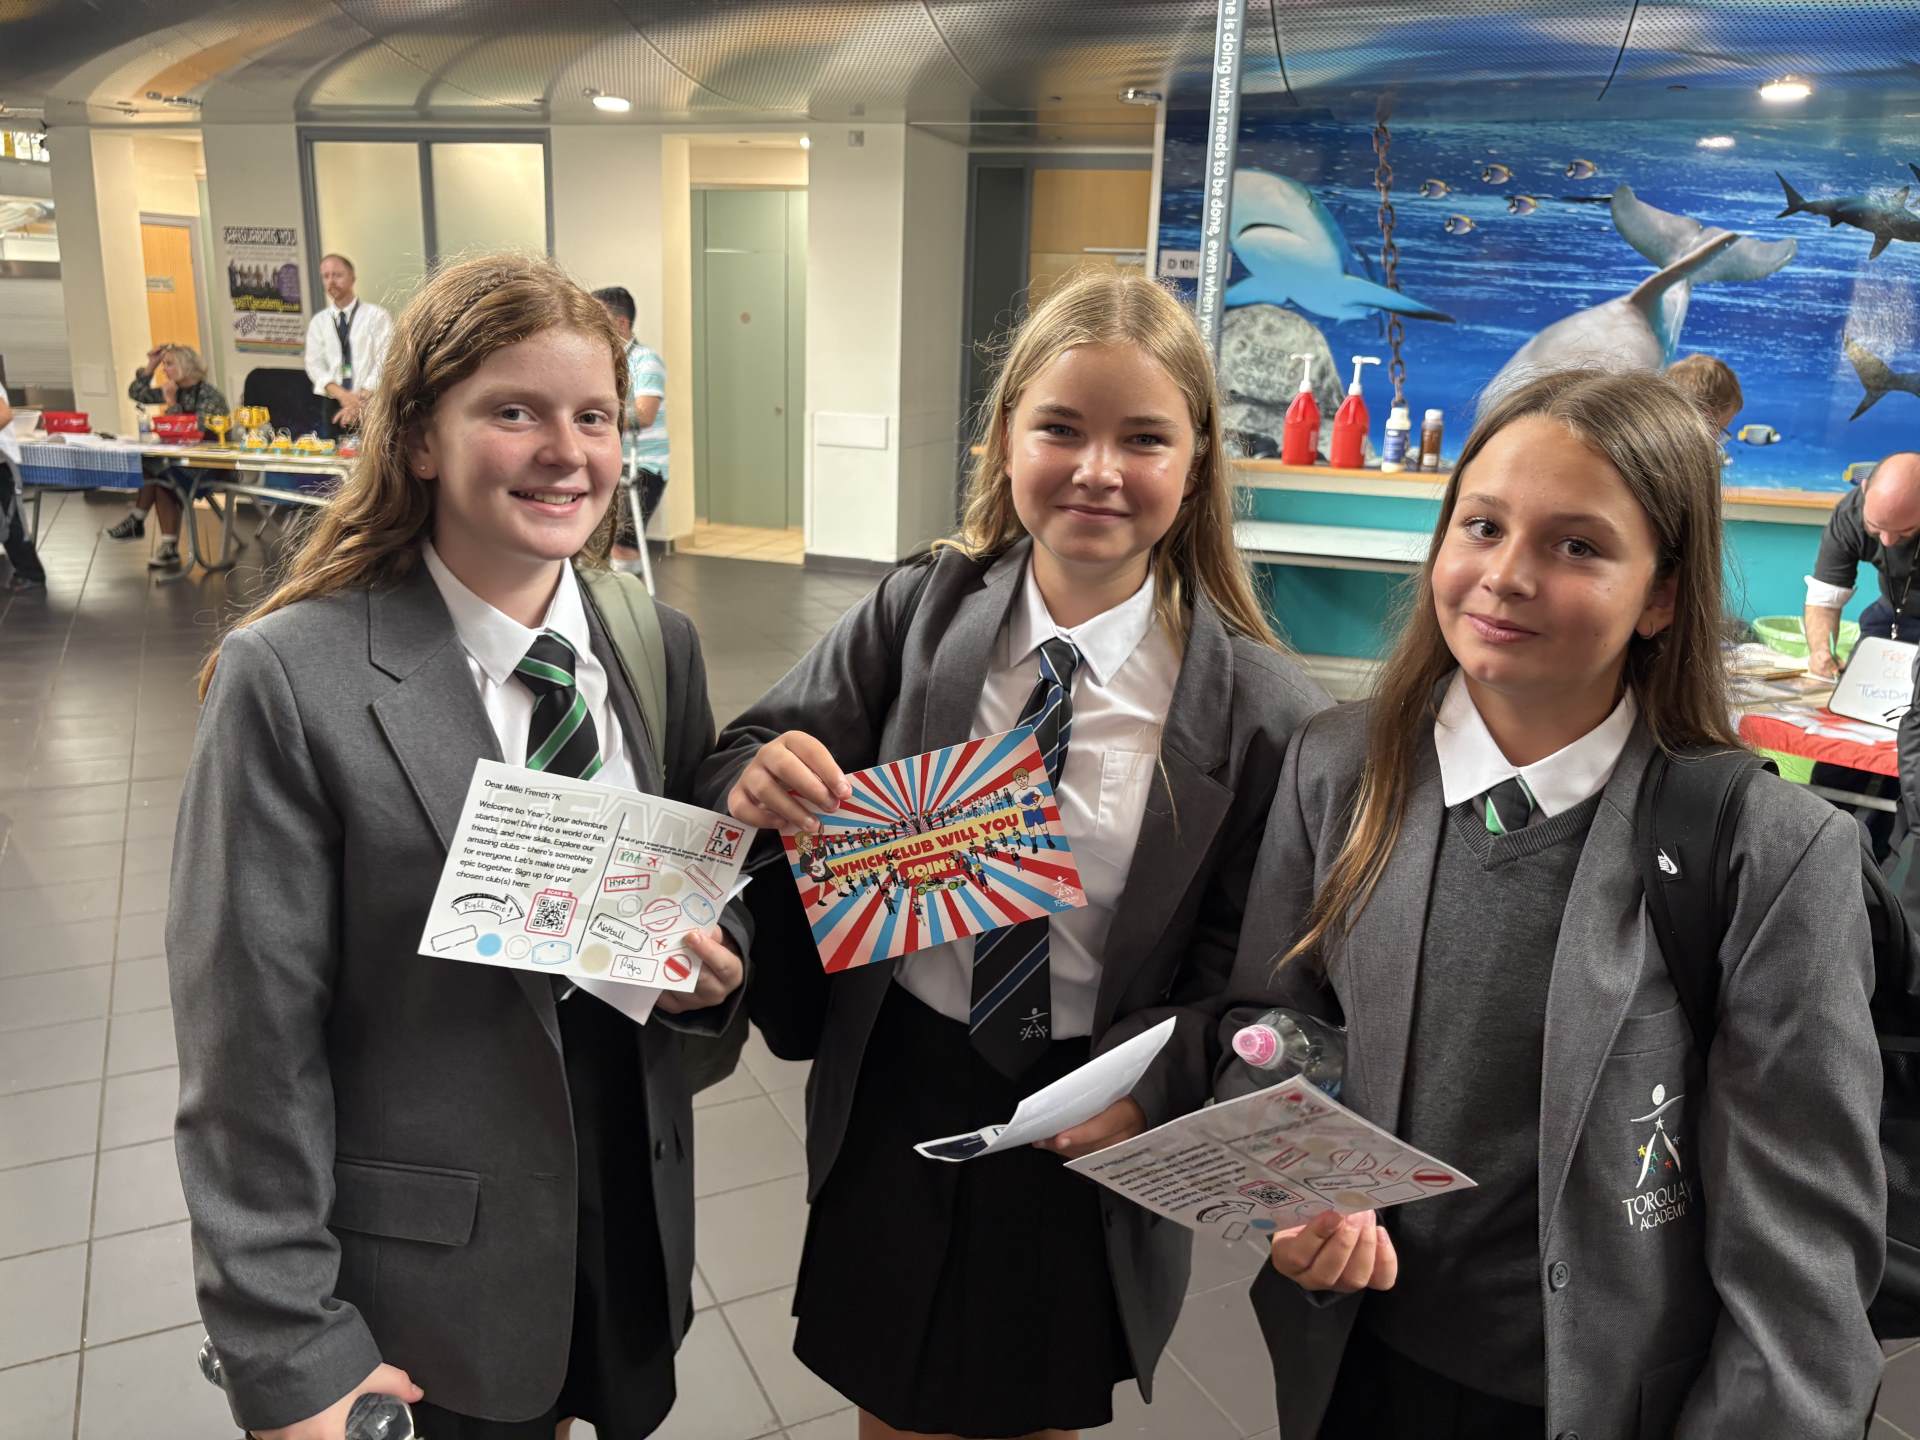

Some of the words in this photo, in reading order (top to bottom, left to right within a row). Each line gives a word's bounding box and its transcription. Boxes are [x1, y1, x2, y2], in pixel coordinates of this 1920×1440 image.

[1223, 18, 1238, 30] is
[1217, 32, 1238, 74] doing
[1217, 77, 1234, 114] what
[1213, 116, 1230, 159] needs
[1212, 160, 1227, 176] to
[1211, 178, 1228, 196] be
[1206, 198, 1226, 237] done,
[1205, 239, 1220, 274] even
[1202, 276, 1219, 313] when
[484, 779, 503, 790] Dear
[524, 787, 551, 799] French
[474, 812, 500, 823] starts
[500, 817, 520, 827] now!
[520, 820, 538, 830] Dive
[539, 824, 554, 833] into
[562, 829, 583, 838] world
[592, 834, 605, 843] fun,
[480, 800, 514, 813] Welcome
[527, 808, 545, 818] Year
[552, 815, 570, 823] your
[570, 818, 608, 831] adventure
[470, 824, 499, 836] friends,
[500, 829, 515, 838] and
[516, 832, 532, 841] new
[554, 838, 582, 850] Explore
[582, 844, 595, 852] our
[715, 826, 727, 839] I
[831, 854, 889, 877] WHICH
[892, 839, 934, 859] CLUB
[935, 826, 979, 848] WILL
[979, 813, 1020, 836] YOU
[464, 847, 475, 855] for
[476, 850, 513, 862] everyone.
[534, 859, 555, 869] make
[556, 863, 572, 872] this
[571, 865, 589, 875] year
[466, 836, 499, 848] amazing
[500, 840, 520, 851] clubs
[555, 850, 594, 865] something
[710, 840, 733, 857] TA
[456, 871, 484, 881] chosen
[485, 875, 511, 886] club(s)
[460, 860, 476, 868] epic
[478, 862, 514, 874] together.
[514, 868, 532, 878] Sign
[532, 872, 542, 880] up
[544, 872, 554, 880] for
[554, 875, 573, 884] your
[907, 857, 956, 880] JOIN?
